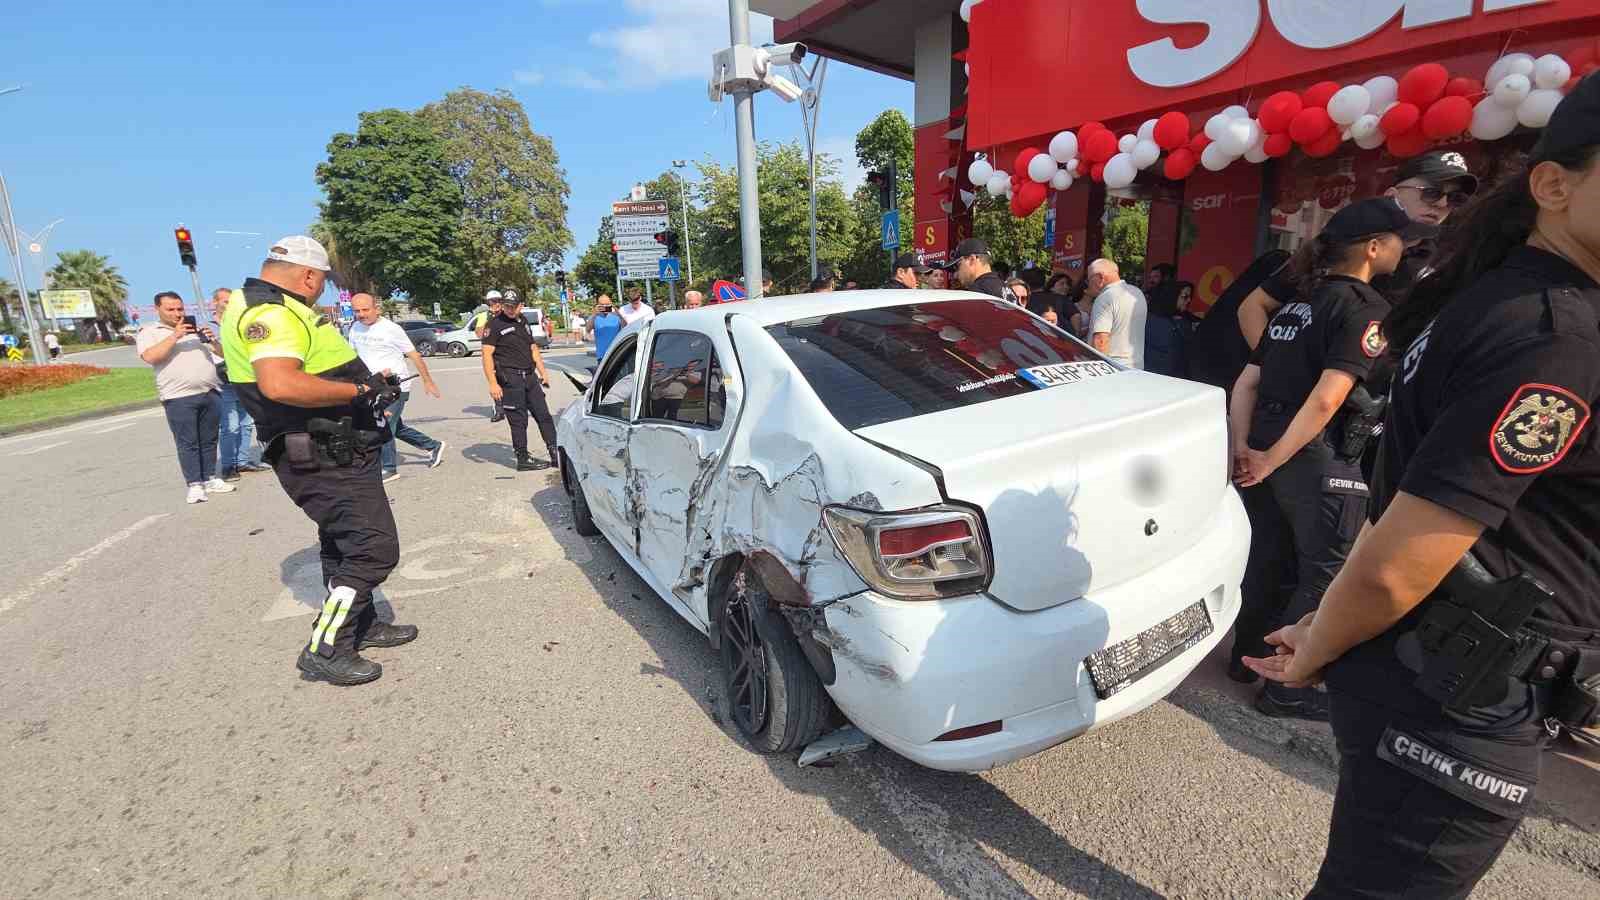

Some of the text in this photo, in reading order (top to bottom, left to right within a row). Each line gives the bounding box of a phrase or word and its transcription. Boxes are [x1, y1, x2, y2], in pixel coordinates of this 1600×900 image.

[1193, 194, 1226, 211] sar
[925, 226, 935, 246] S
[1394, 735, 1528, 804] ÇEVİK KUVVET
